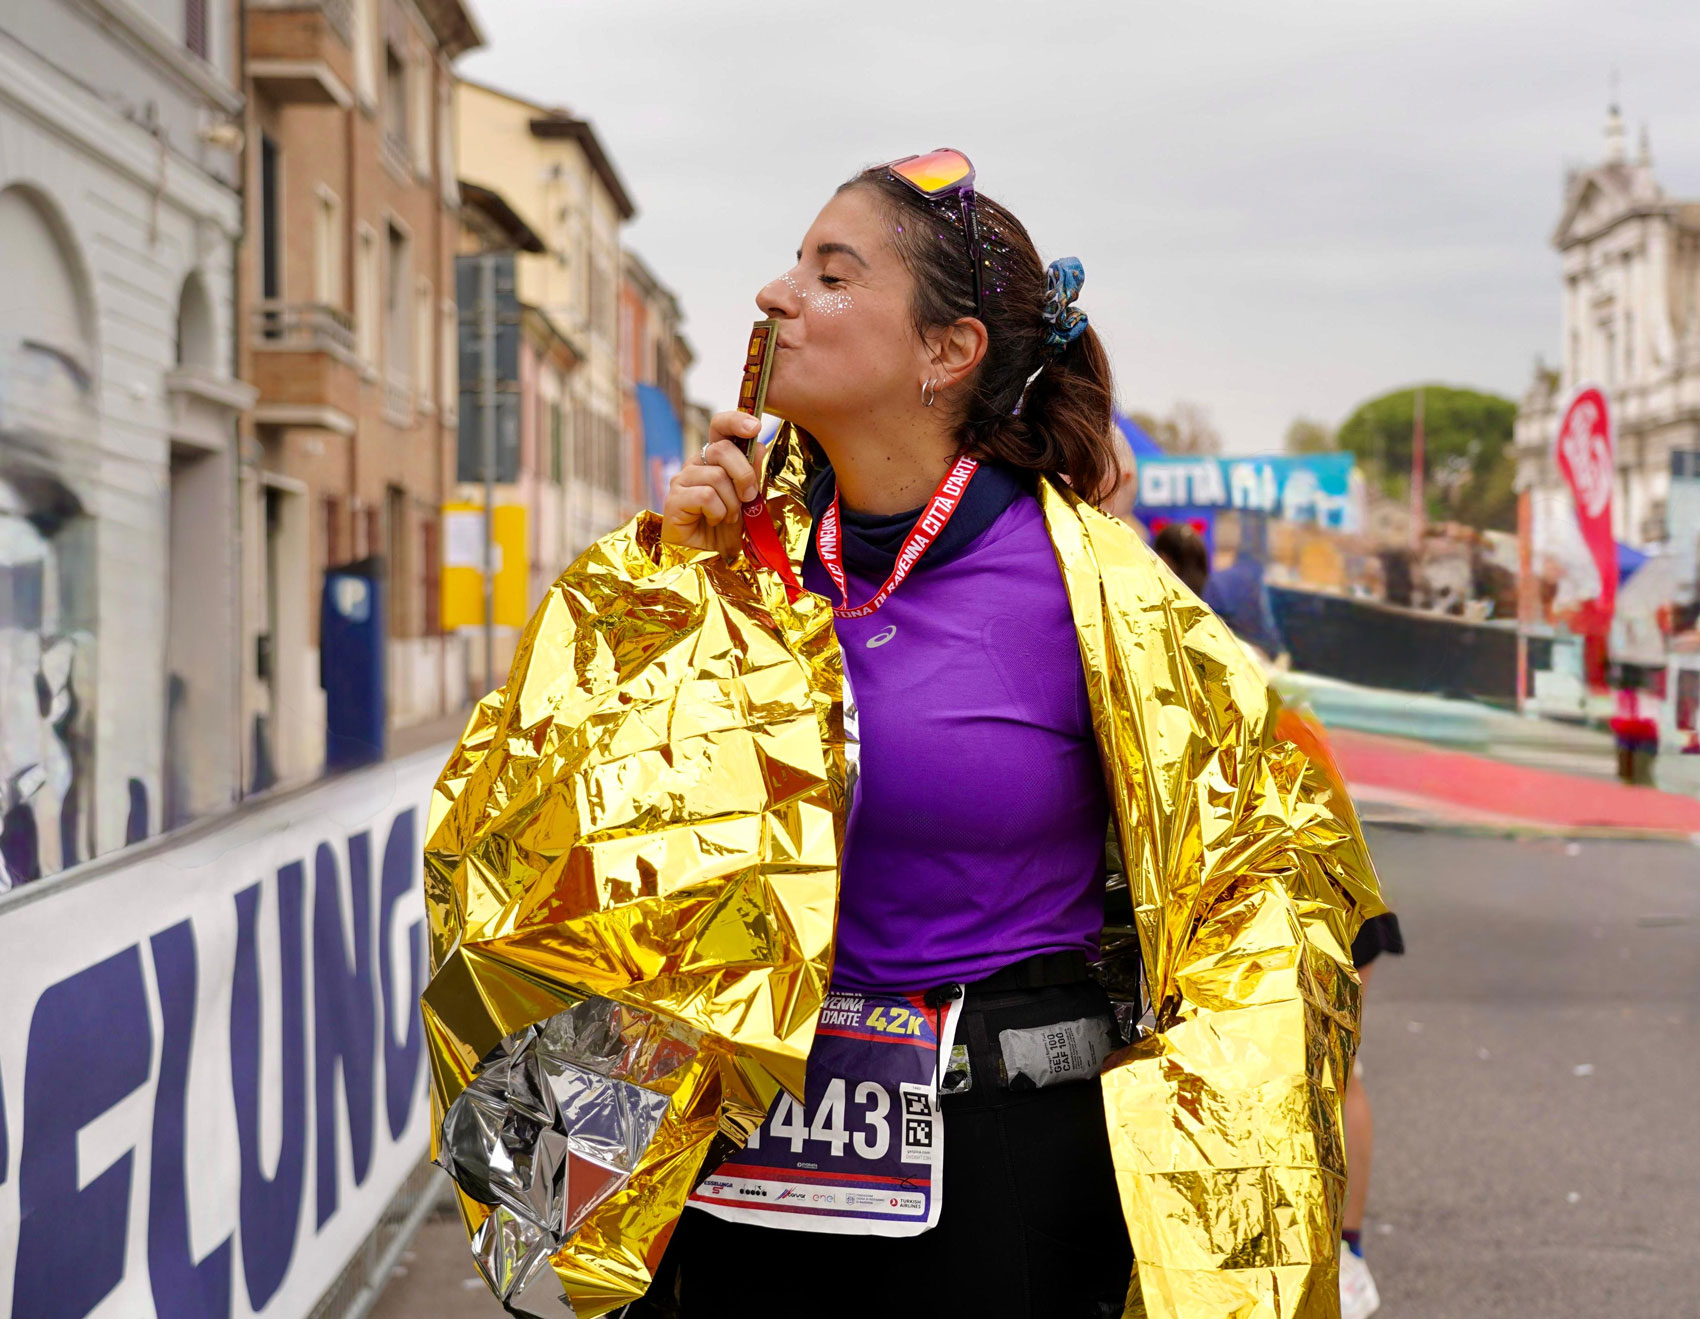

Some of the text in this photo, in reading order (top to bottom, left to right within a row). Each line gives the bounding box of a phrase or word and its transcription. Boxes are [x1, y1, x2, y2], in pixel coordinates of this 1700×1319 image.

[820, 507, 837, 560] RAVENNA
[834, 606, 872, 618] TONA
[874, 592, 887, 608] DI
[887, 534, 929, 594] RAVENNA
[922, 496, 955, 536] CITTÀ
[821, 1006, 925, 1036] D'ARTE 42K
[822, 996, 865, 1012] VENNA
[0, 805, 428, 1319] ELUNG
[1047, 1034, 1063, 1073] GEL 100
[1055, 1032, 1071, 1071] CAF 100
[812, 1193, 836, 1203] enel
